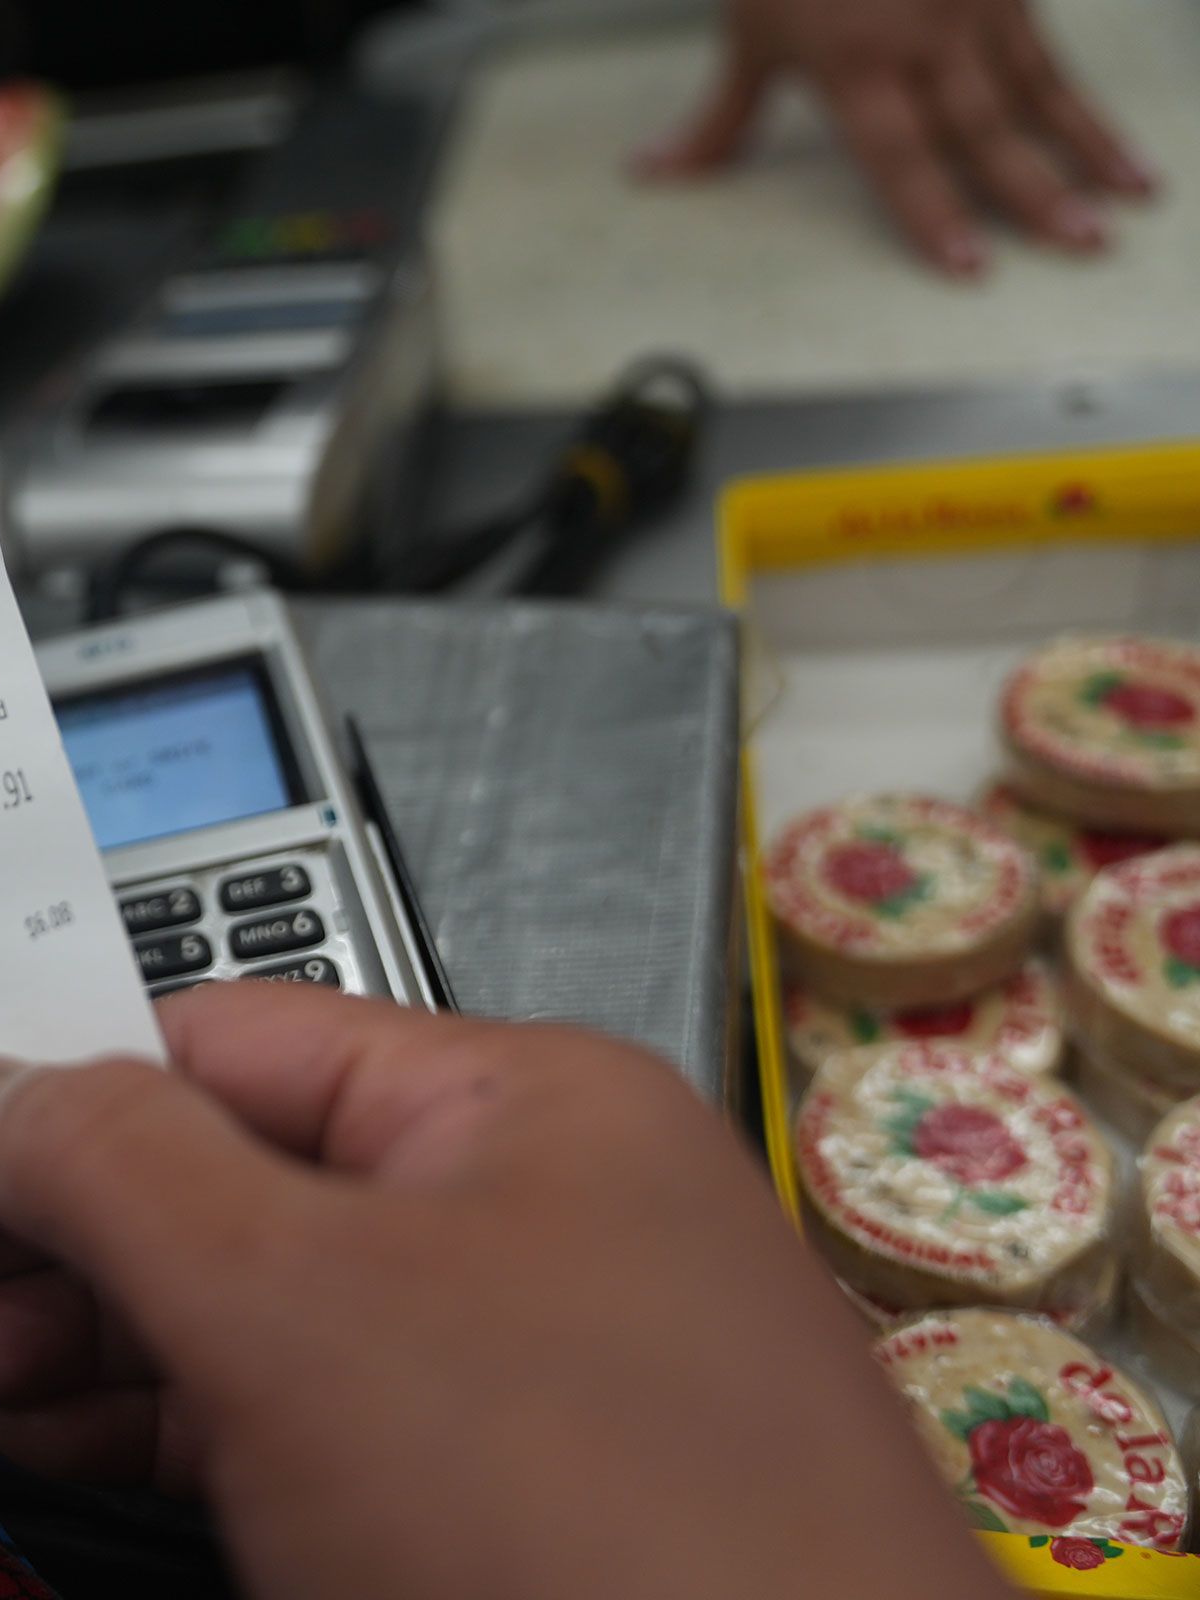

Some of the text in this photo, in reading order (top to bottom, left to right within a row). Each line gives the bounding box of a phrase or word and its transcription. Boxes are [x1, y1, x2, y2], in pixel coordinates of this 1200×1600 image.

[280, 864, 305, 893] 3
[239, 910, 315, 946] MNO 6
[179, 933, 200, 962] 5
